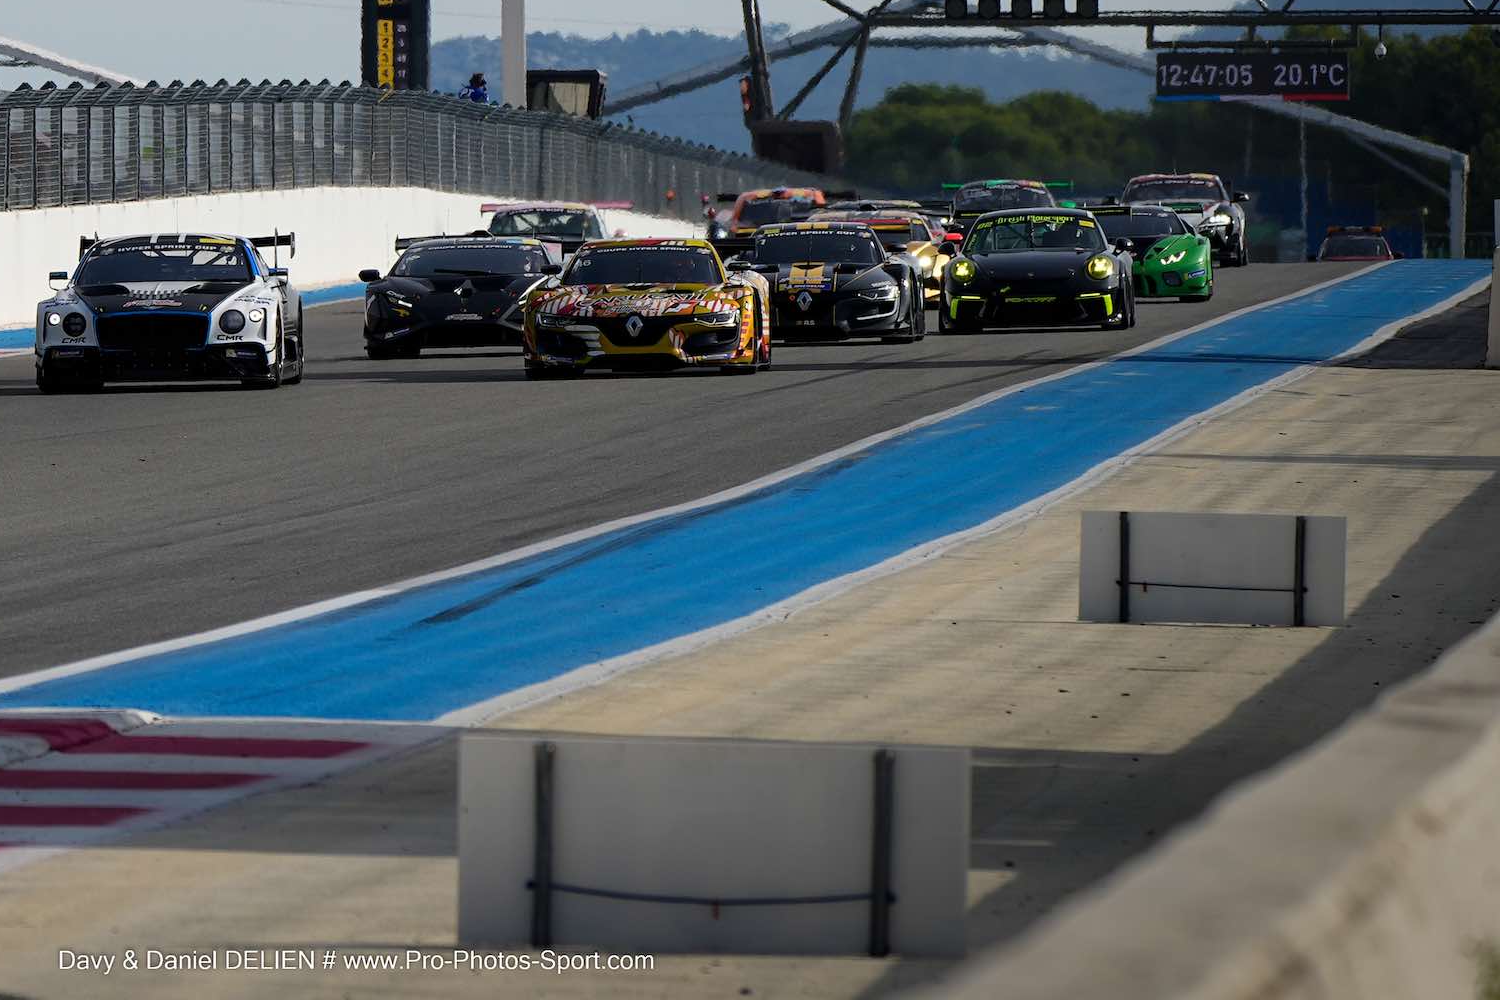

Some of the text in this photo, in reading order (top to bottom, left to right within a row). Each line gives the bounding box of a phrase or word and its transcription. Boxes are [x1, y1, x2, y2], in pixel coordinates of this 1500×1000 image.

[1159, 64, 1253, 86] 12:47:05
[116, 244, 152, 253] HYPER
[61, 336, 87, 344] CMR
[216, 333, 244, 341] CMR
